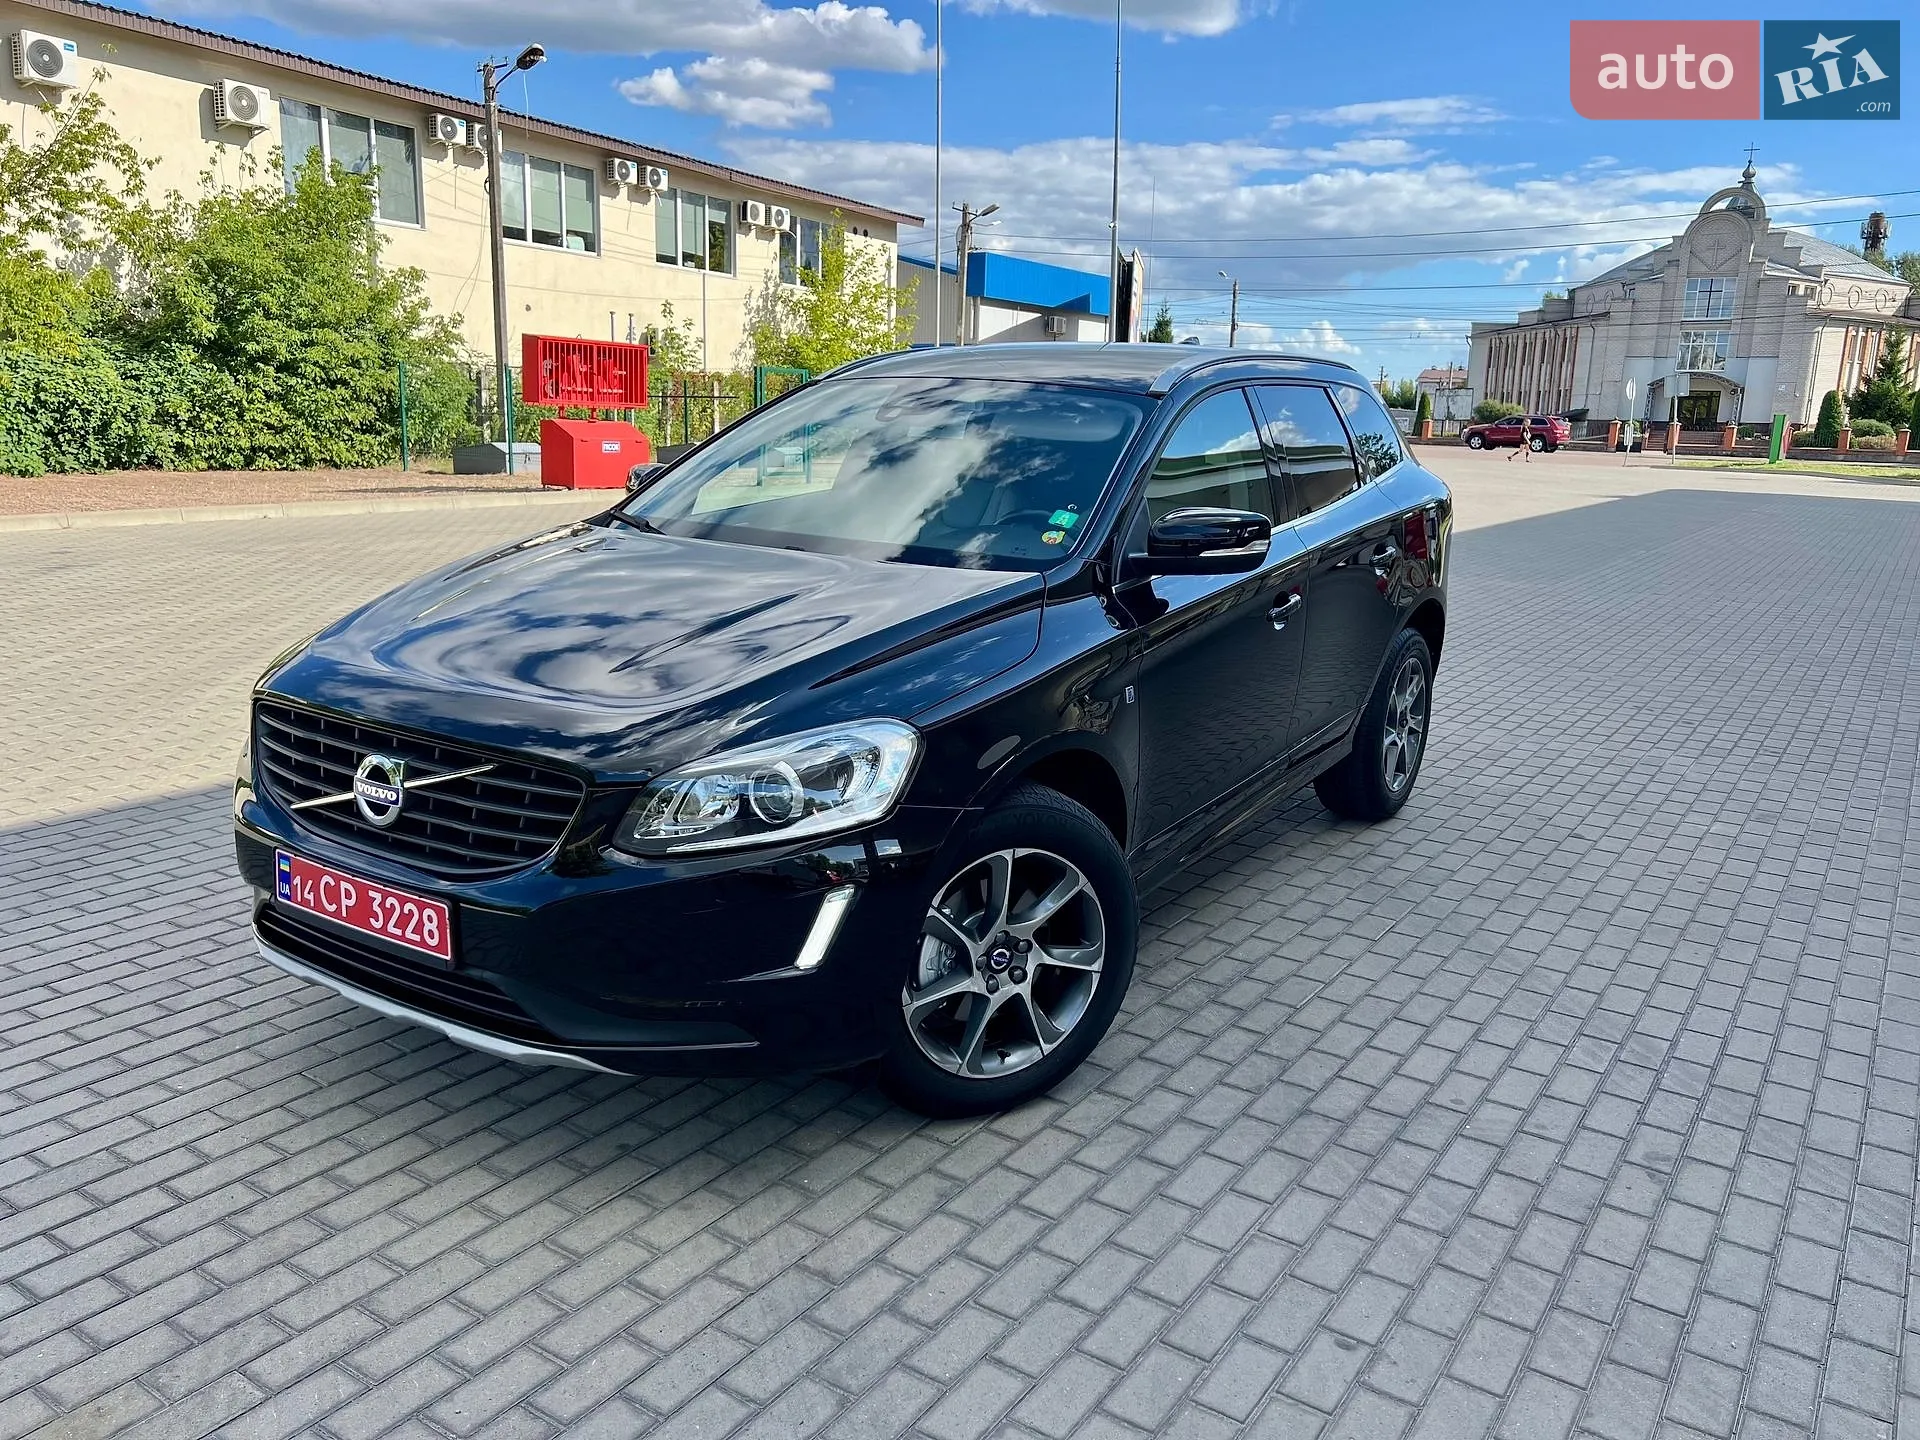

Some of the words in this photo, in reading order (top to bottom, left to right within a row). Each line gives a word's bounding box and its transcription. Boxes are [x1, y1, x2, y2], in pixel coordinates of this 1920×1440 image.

[356, 781, 397, 801] VOLVO
[280, 882, 291, 896] UA
[368, 890, 440, 947] 3228
